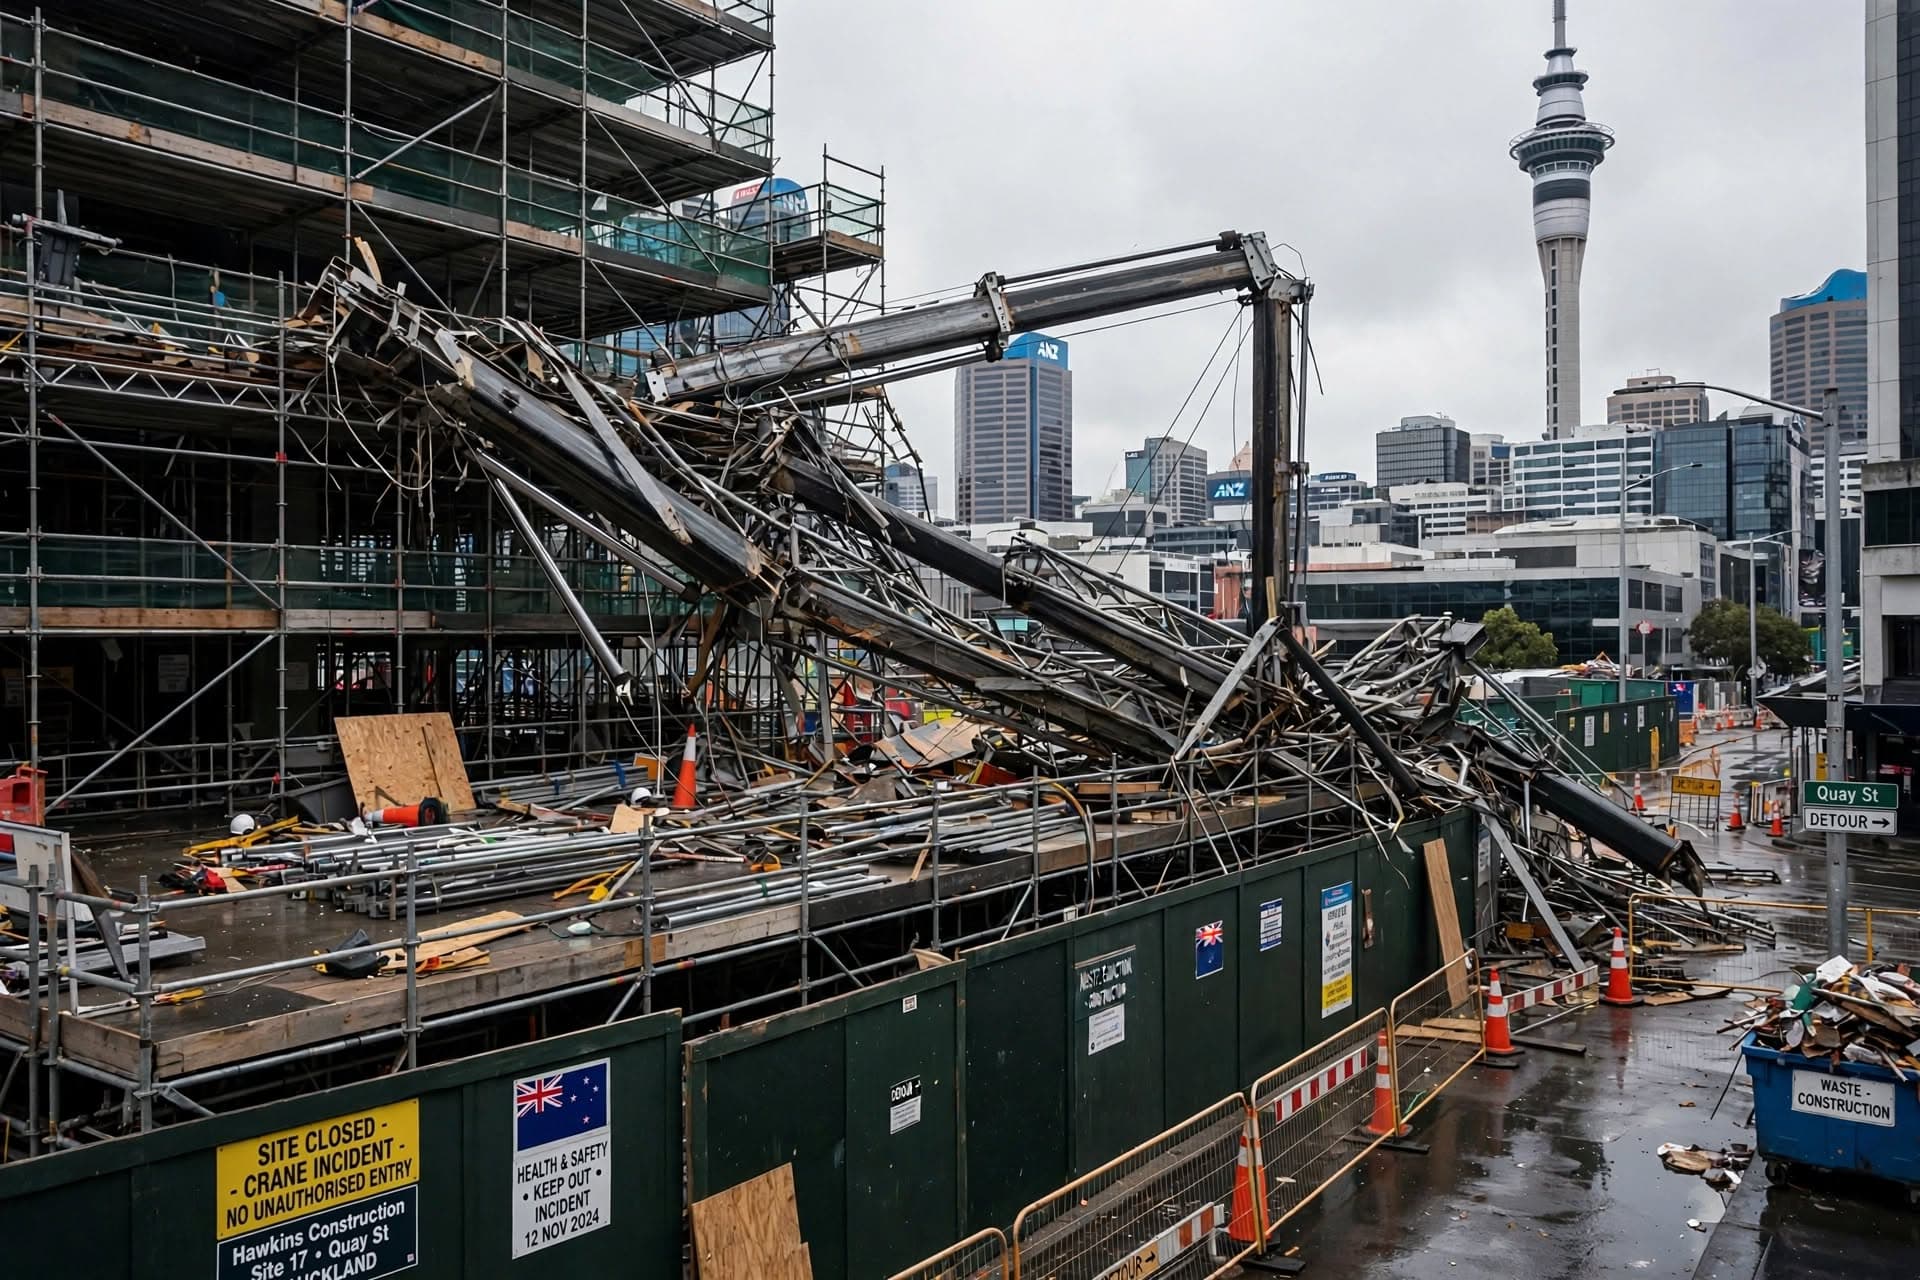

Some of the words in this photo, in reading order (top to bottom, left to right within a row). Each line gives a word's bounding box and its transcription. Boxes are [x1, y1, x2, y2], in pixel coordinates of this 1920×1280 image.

[1214, 482, 1245, 498] ANZ
[1817, 785, 1856, 804] Quay
[1862, 787, 1879, 802] St
[1810, 813, 1867, 829] DETOUR
[1820, 1079, 1862, 1097] WASTE
[1798, 1092, 1890, 1120] CONSTRUCTION
[258, 1135, 299, 1166] SITE
[305, 1117, 375, 1153] CLOSED
[244, 1161, 307, 1198] CRANE
[314, 1138, 394, 1180] INCIDENT
[518, 1156, 557, 1184] HEALTH
[561, 1154, 568, 1170] &
[571, 1141, 608, 1167] SAFETY
[226, 1204, 248, 1229] NO
[254, 1172, 365, 1220] UNAUTHORISED
[370, 1158, 412, 1187] ENTRY
[534, 1176, 564, 1201] KEEP
[568, 1168, 591, 1189] OUT
[535, 1190, 591, 1223] INCIDENT
[232, 1232, 303, 1266] Hawkins
[308, 1200, 405, 1242] Construction
[525, 1230, 538, 1248] 12
[542, 1218, 567, 1243] NOV
[571, 1208, 599, 1233] 2024
[251, 1261, 284, 1280] Site
[290, 1249, 308, 1271] 17
[329, 1233, 368, 1258] Quay
[372, 1224, 389, 1244] St
[290, 1252, 377, 1280] CKLAND
